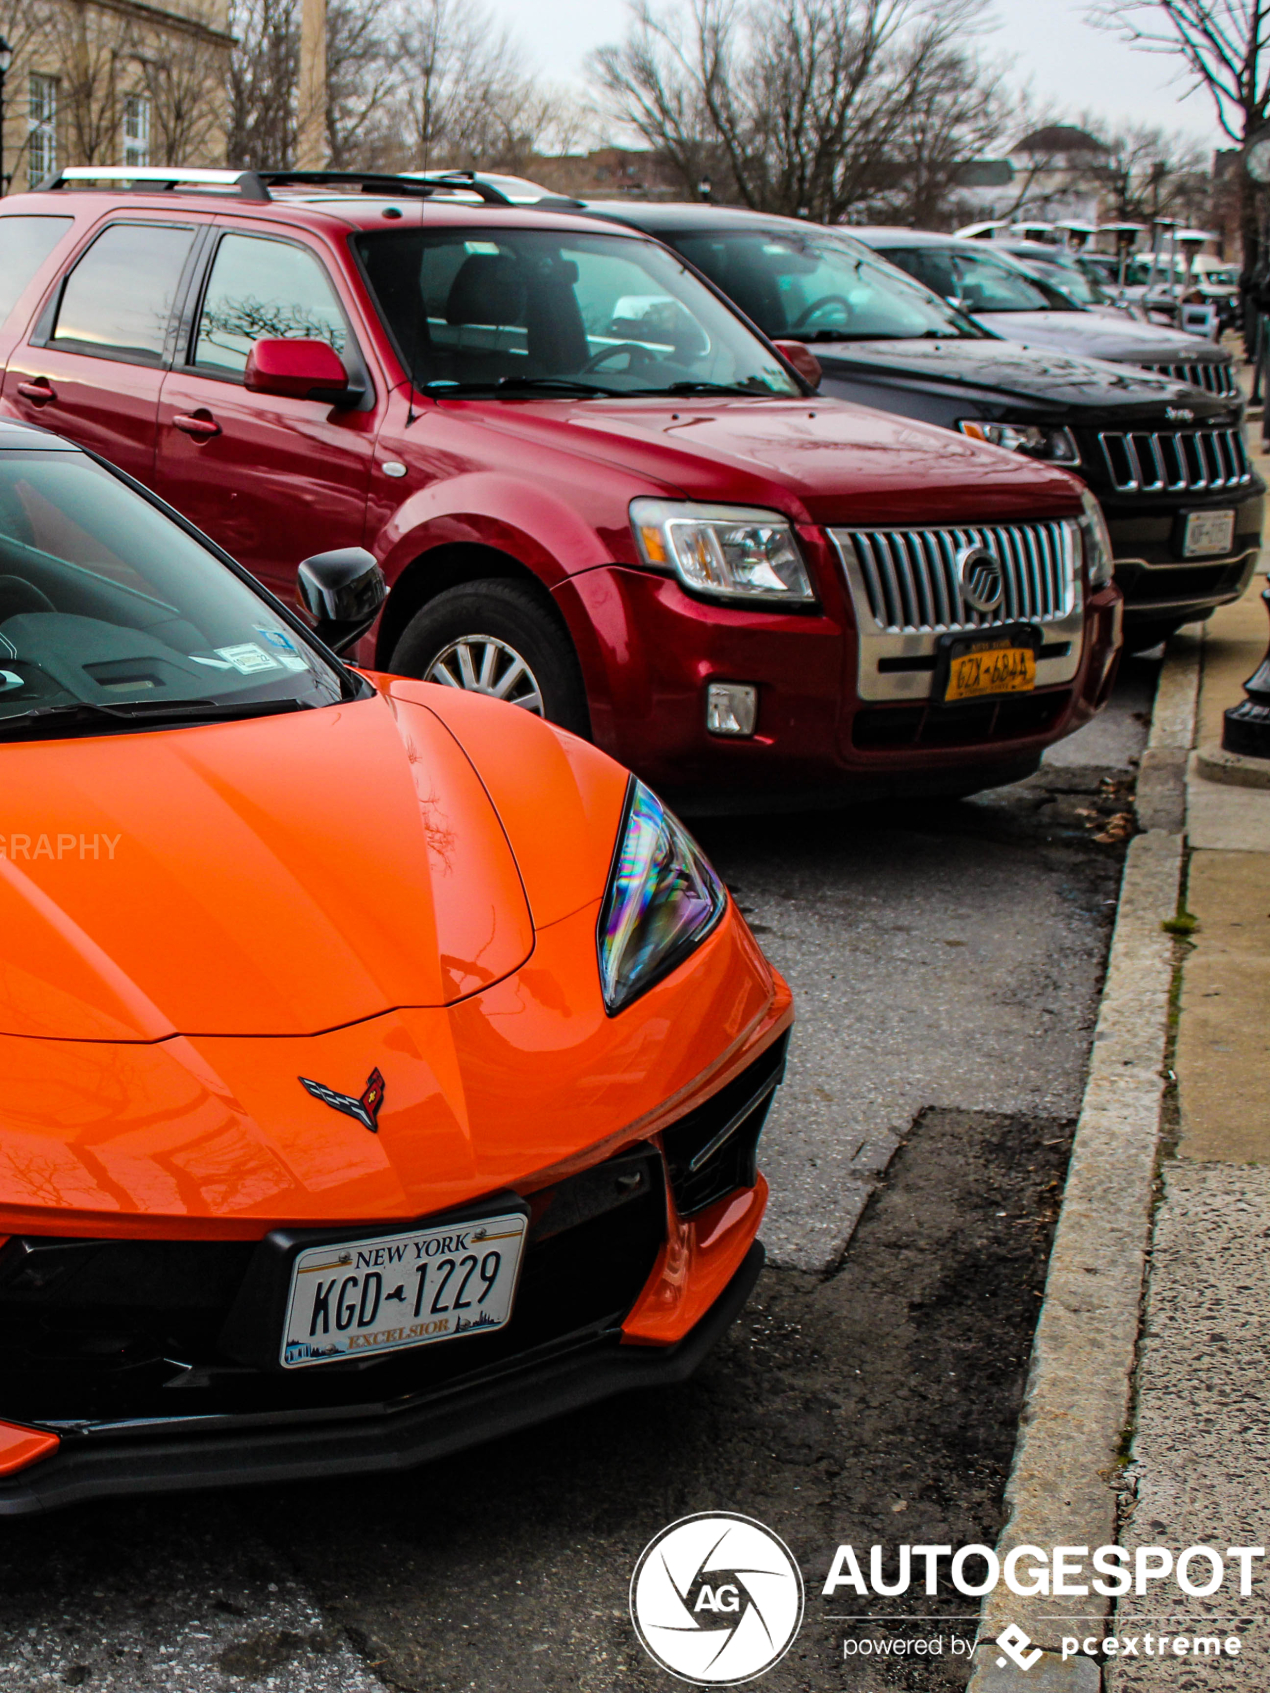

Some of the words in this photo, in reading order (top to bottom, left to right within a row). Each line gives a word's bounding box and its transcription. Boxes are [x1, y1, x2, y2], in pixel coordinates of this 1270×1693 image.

[354, 1243, 408, 1270] NEW
[412, 1232, 472, 1259] YORK
[347, 1318, 450, 1350] EXCELSIOR
